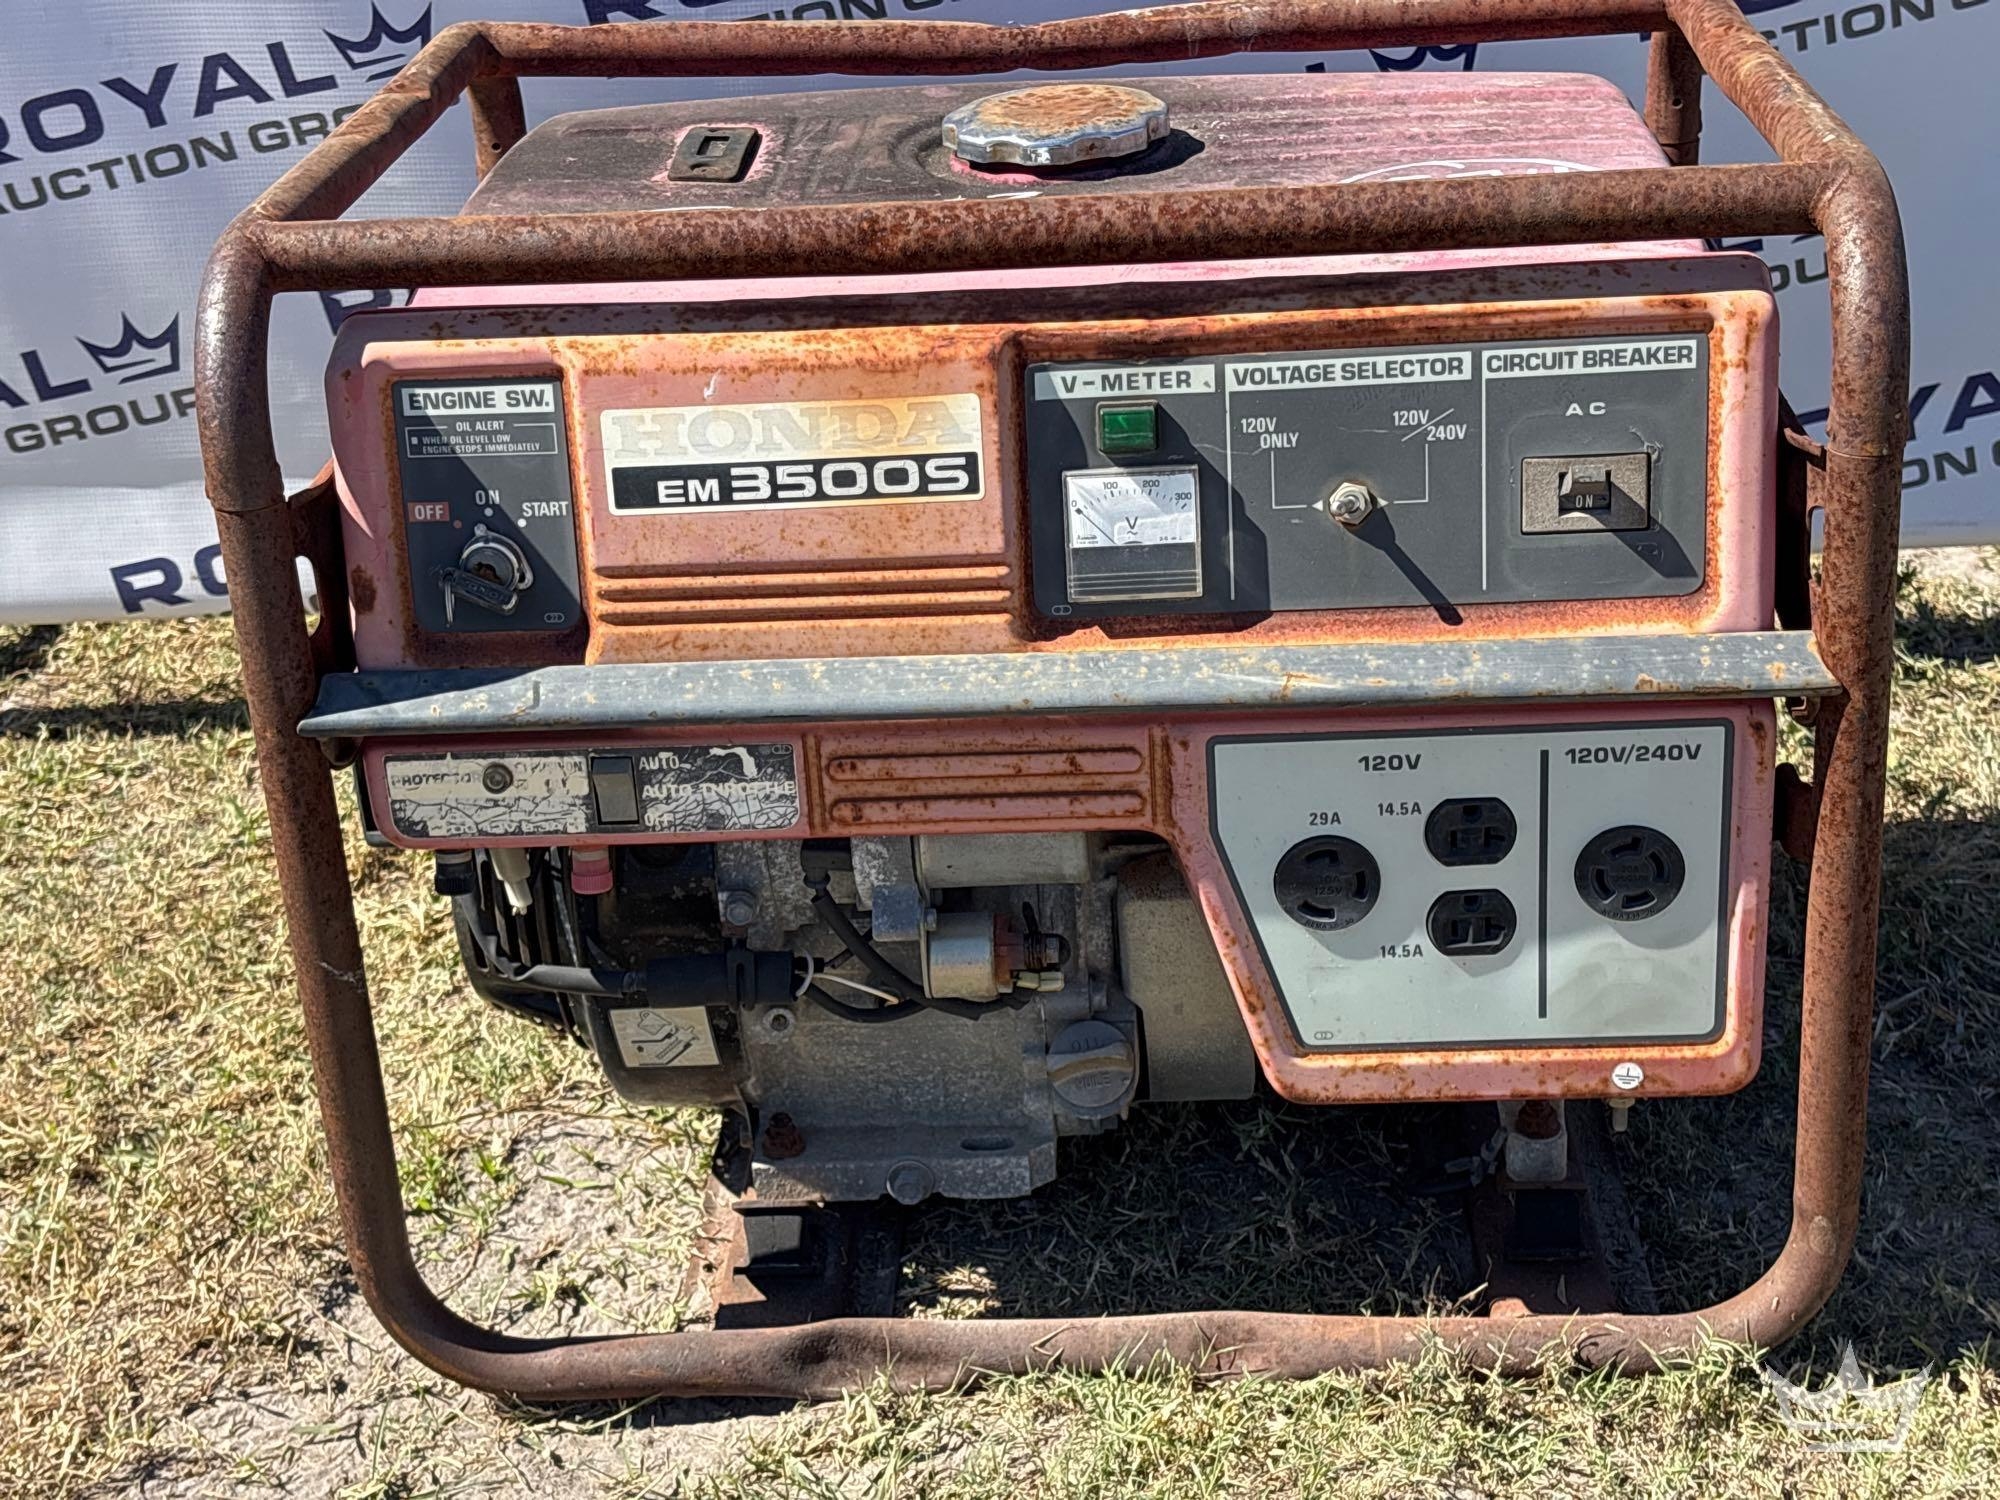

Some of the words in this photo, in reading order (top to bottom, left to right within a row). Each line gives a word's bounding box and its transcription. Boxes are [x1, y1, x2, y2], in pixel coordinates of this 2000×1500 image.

[0, 40, 339, 163] OYAL
[1486, 351, 1578, 373] CIRCUIT
[1583, 345, 1693, 368] BREAKER
[1232, 364, 1336, 386] VOLTAGE
[1340, 357, 1464, 380] SELECTOR
[408, 390, 497, 411] ENGINE
[506, 389, 550, 408] SW.
[455, 421, 473, 432] OIL
[475, 420, 505, 431] ALERT
[611, 401, 973, 459] HONDA
[1241, 417, 1277, 433] 120V
[422, 436, 447, 445] WHEN
[450, 435, 463, 444] OIL
[465, 434, 489, 444] LEVEL
[492, 434, 511, 443] LOW
[1259, 432, 1299, 449] ONLY
[422, 446, 451, 455] ENGINE
[455, 444, 482, 454] STOPS
[485, 443, 540, 452] IMMEDIATELY
[1103, 482, 1118, 490] 100
[1142, 480, 1160, 488] 200
[475, 489, 500, 505] ON
[1071, 500, 1078, 508] 0
[1174, 492, 1192, 500] 300
[1575, 494, 1593, 508] ON
[414, 504, 444, 520] OFF
[522, 501, 568, 517] START
[1125, 516, 1139, 530] V
[1358, 753, 1422, 772] 120V
[1564, 744, 1702, 765] 120V/240V
[639, 756, 680, 770] AUTO
[1377, 802, 1422, 817] 14.5A
[1309, 811, 1342, 827] 29A
[1379, 944, 1424, 960] 14.5A
